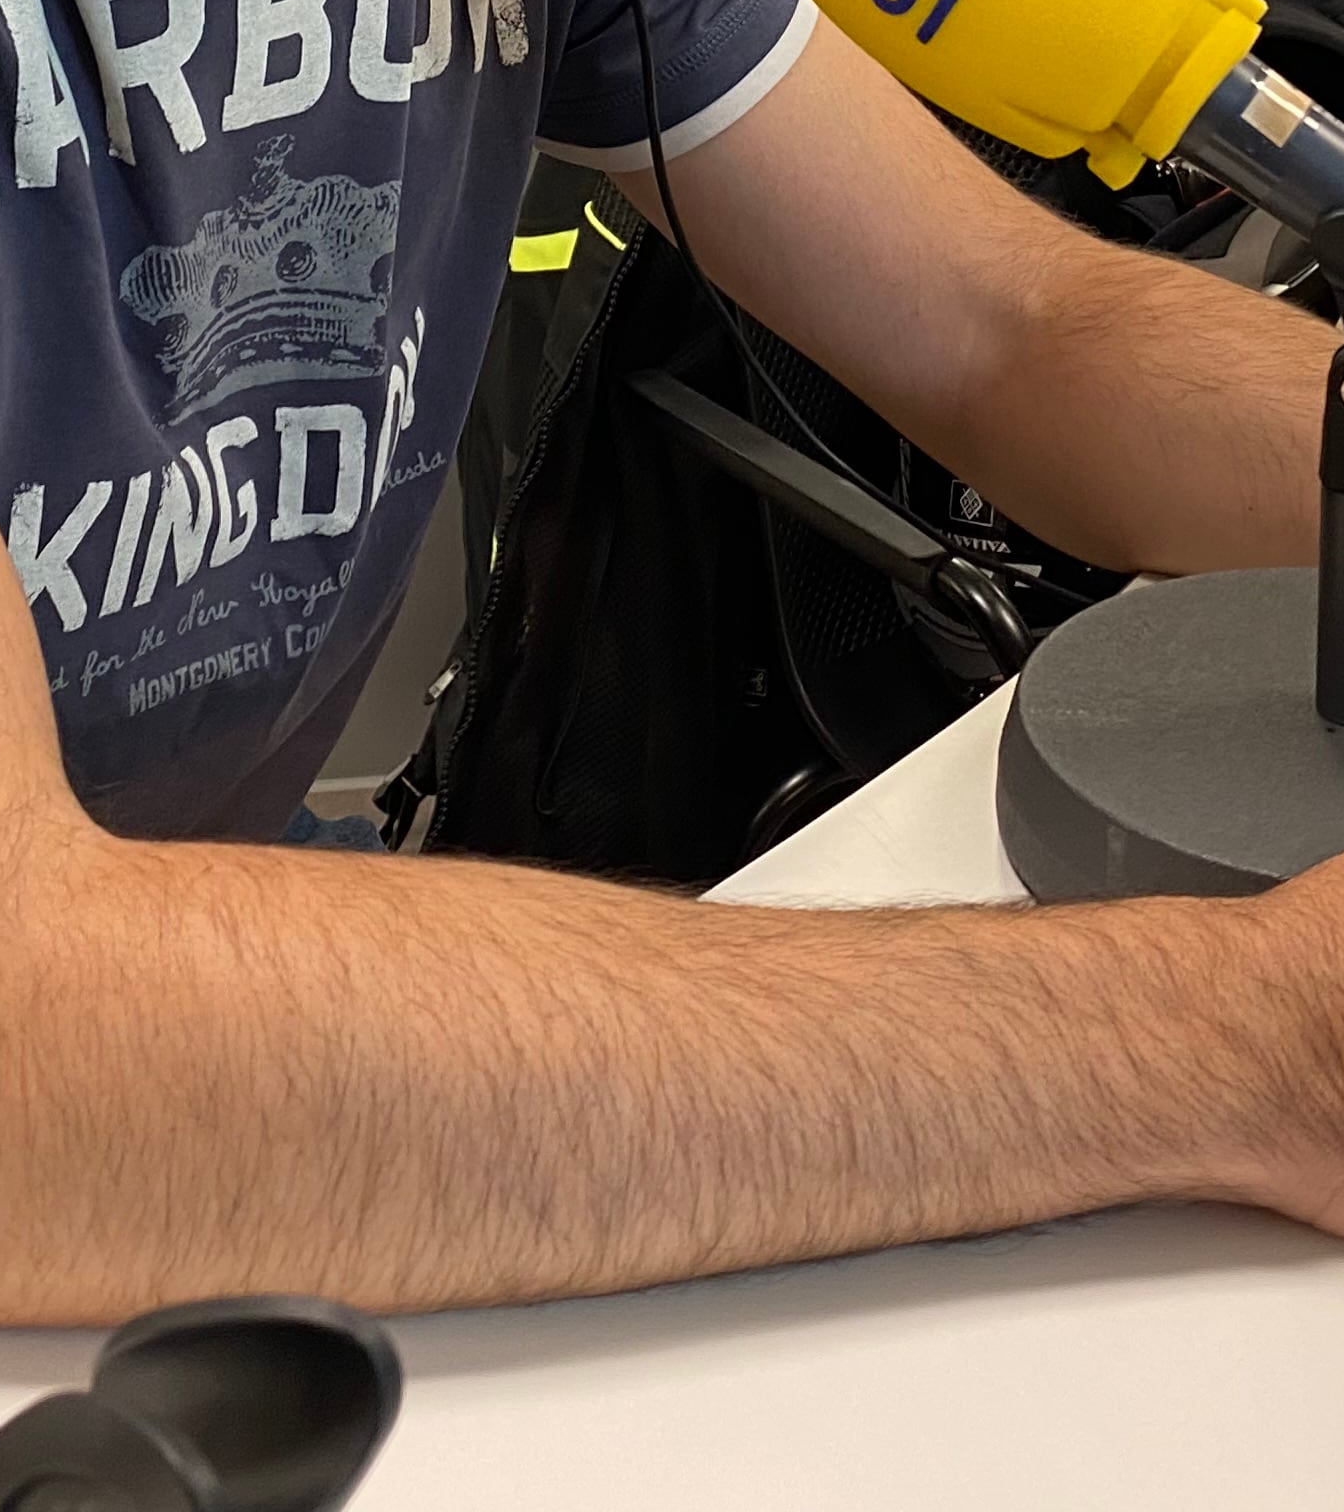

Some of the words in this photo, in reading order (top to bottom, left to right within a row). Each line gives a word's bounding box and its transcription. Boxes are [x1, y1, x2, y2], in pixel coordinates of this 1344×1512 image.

[79, 649, 125, 697] for
[176, 588, 240, 636] New
[250, 557, 356, 618] Royal
[128, 637, 273, 717] MONTGOMERY
